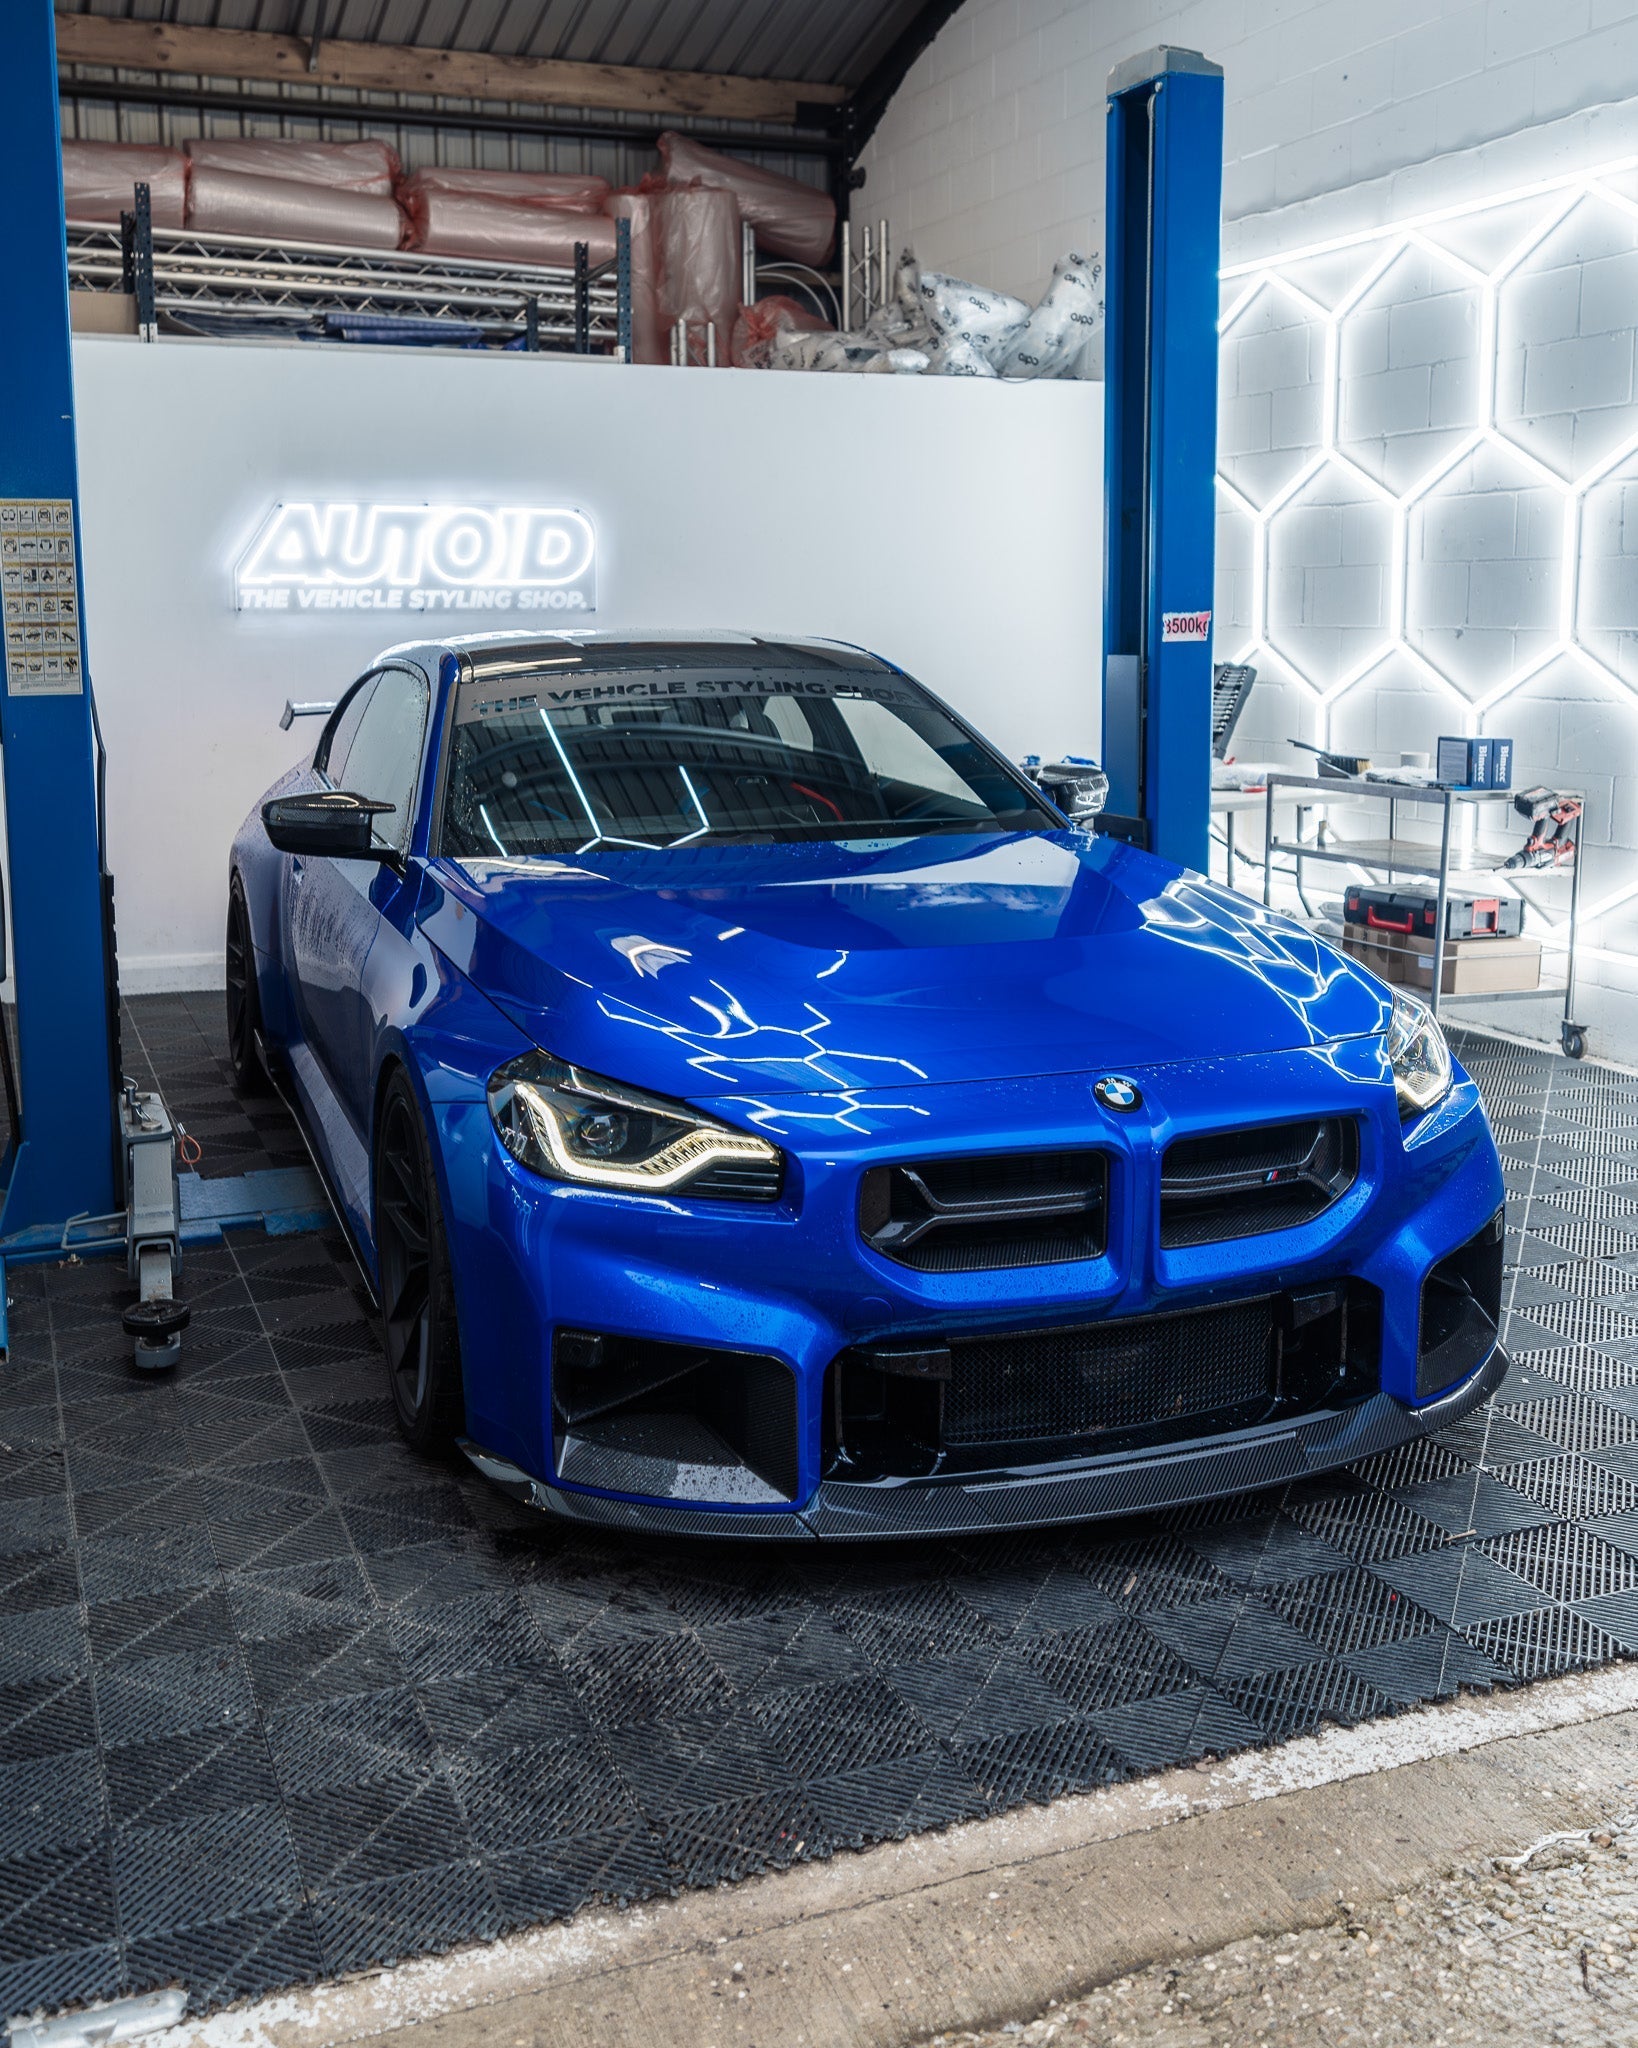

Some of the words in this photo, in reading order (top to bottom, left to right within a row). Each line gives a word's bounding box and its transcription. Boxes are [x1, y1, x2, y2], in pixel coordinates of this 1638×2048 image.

[239, 588, 290, 609] THE
[296, 588, 403, 609] VEHICLE
[408, 588, 511, 609] STYLING
[516, 589, 588, 610] SHOP.
[473, 694, 539, 714] THE
[547, 680, 688, 704] VEHICLE
[695, 680, 827, 695] STYLING
[1096, 1077, 1131, 1090] BMW
